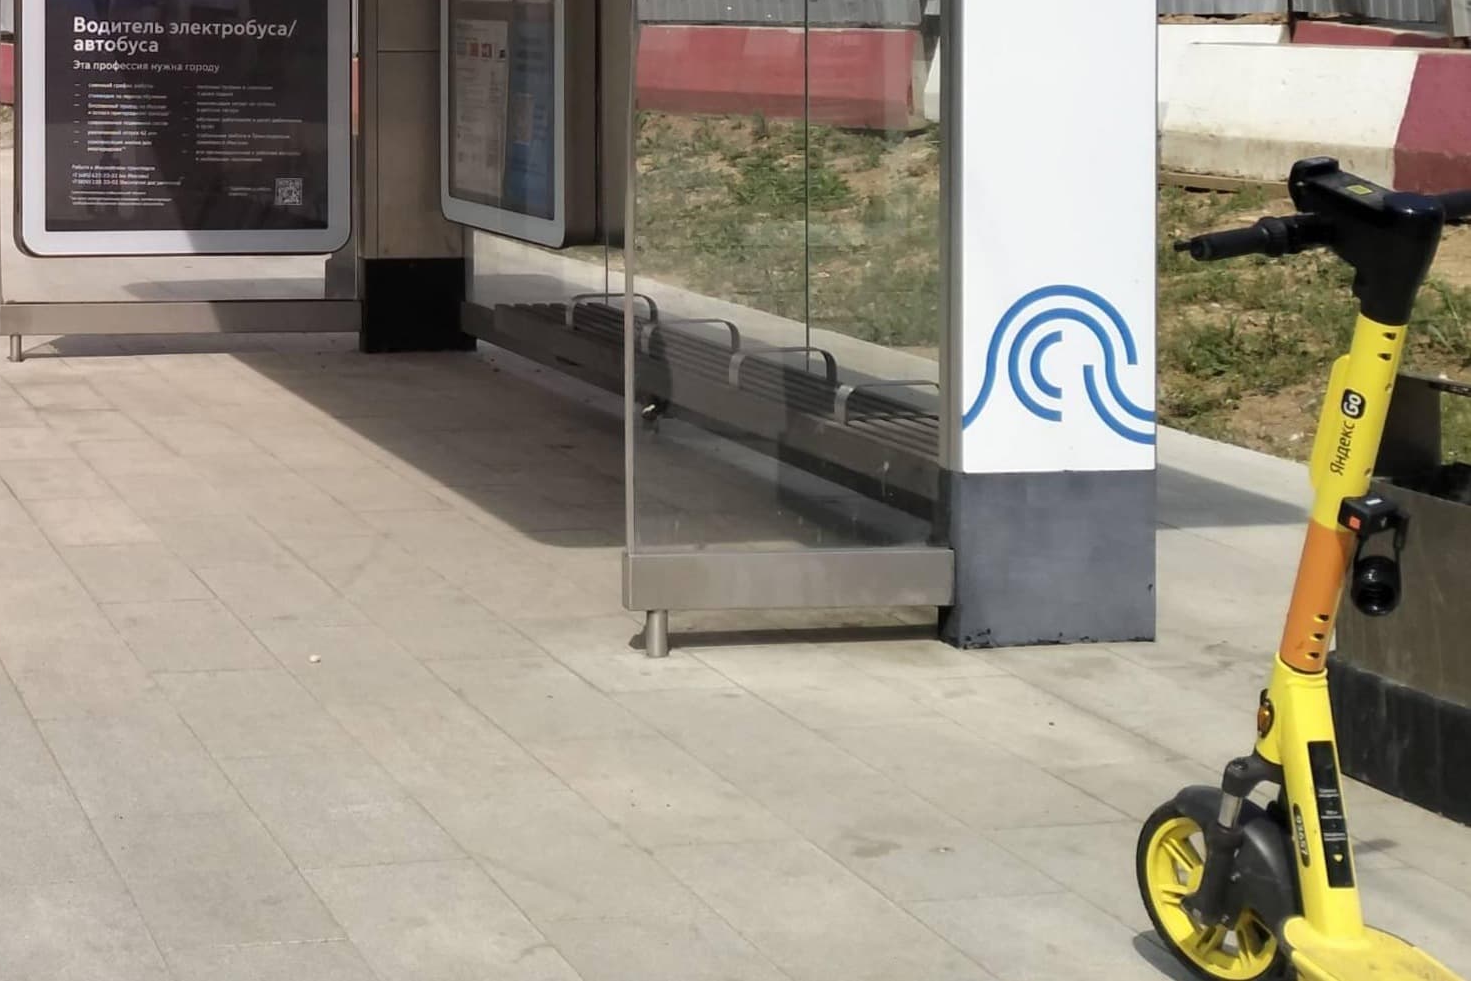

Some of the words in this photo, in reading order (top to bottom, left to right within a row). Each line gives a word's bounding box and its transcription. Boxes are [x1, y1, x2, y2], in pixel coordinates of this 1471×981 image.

[73, 17, 164, 36] Водитель
[169, 19, 298, 39] электробуса/
[73, 36, 159, 55] автобуса
[73, 60, 91, 70] Эта
[93, 60, 149, 72] профессия
[151, 63, 183, 73] нужна
[185, 63, 220, 73] городу
[1330, 421, 1355, 476] Яндекс
[1343, 394, 1362, 416] Go
